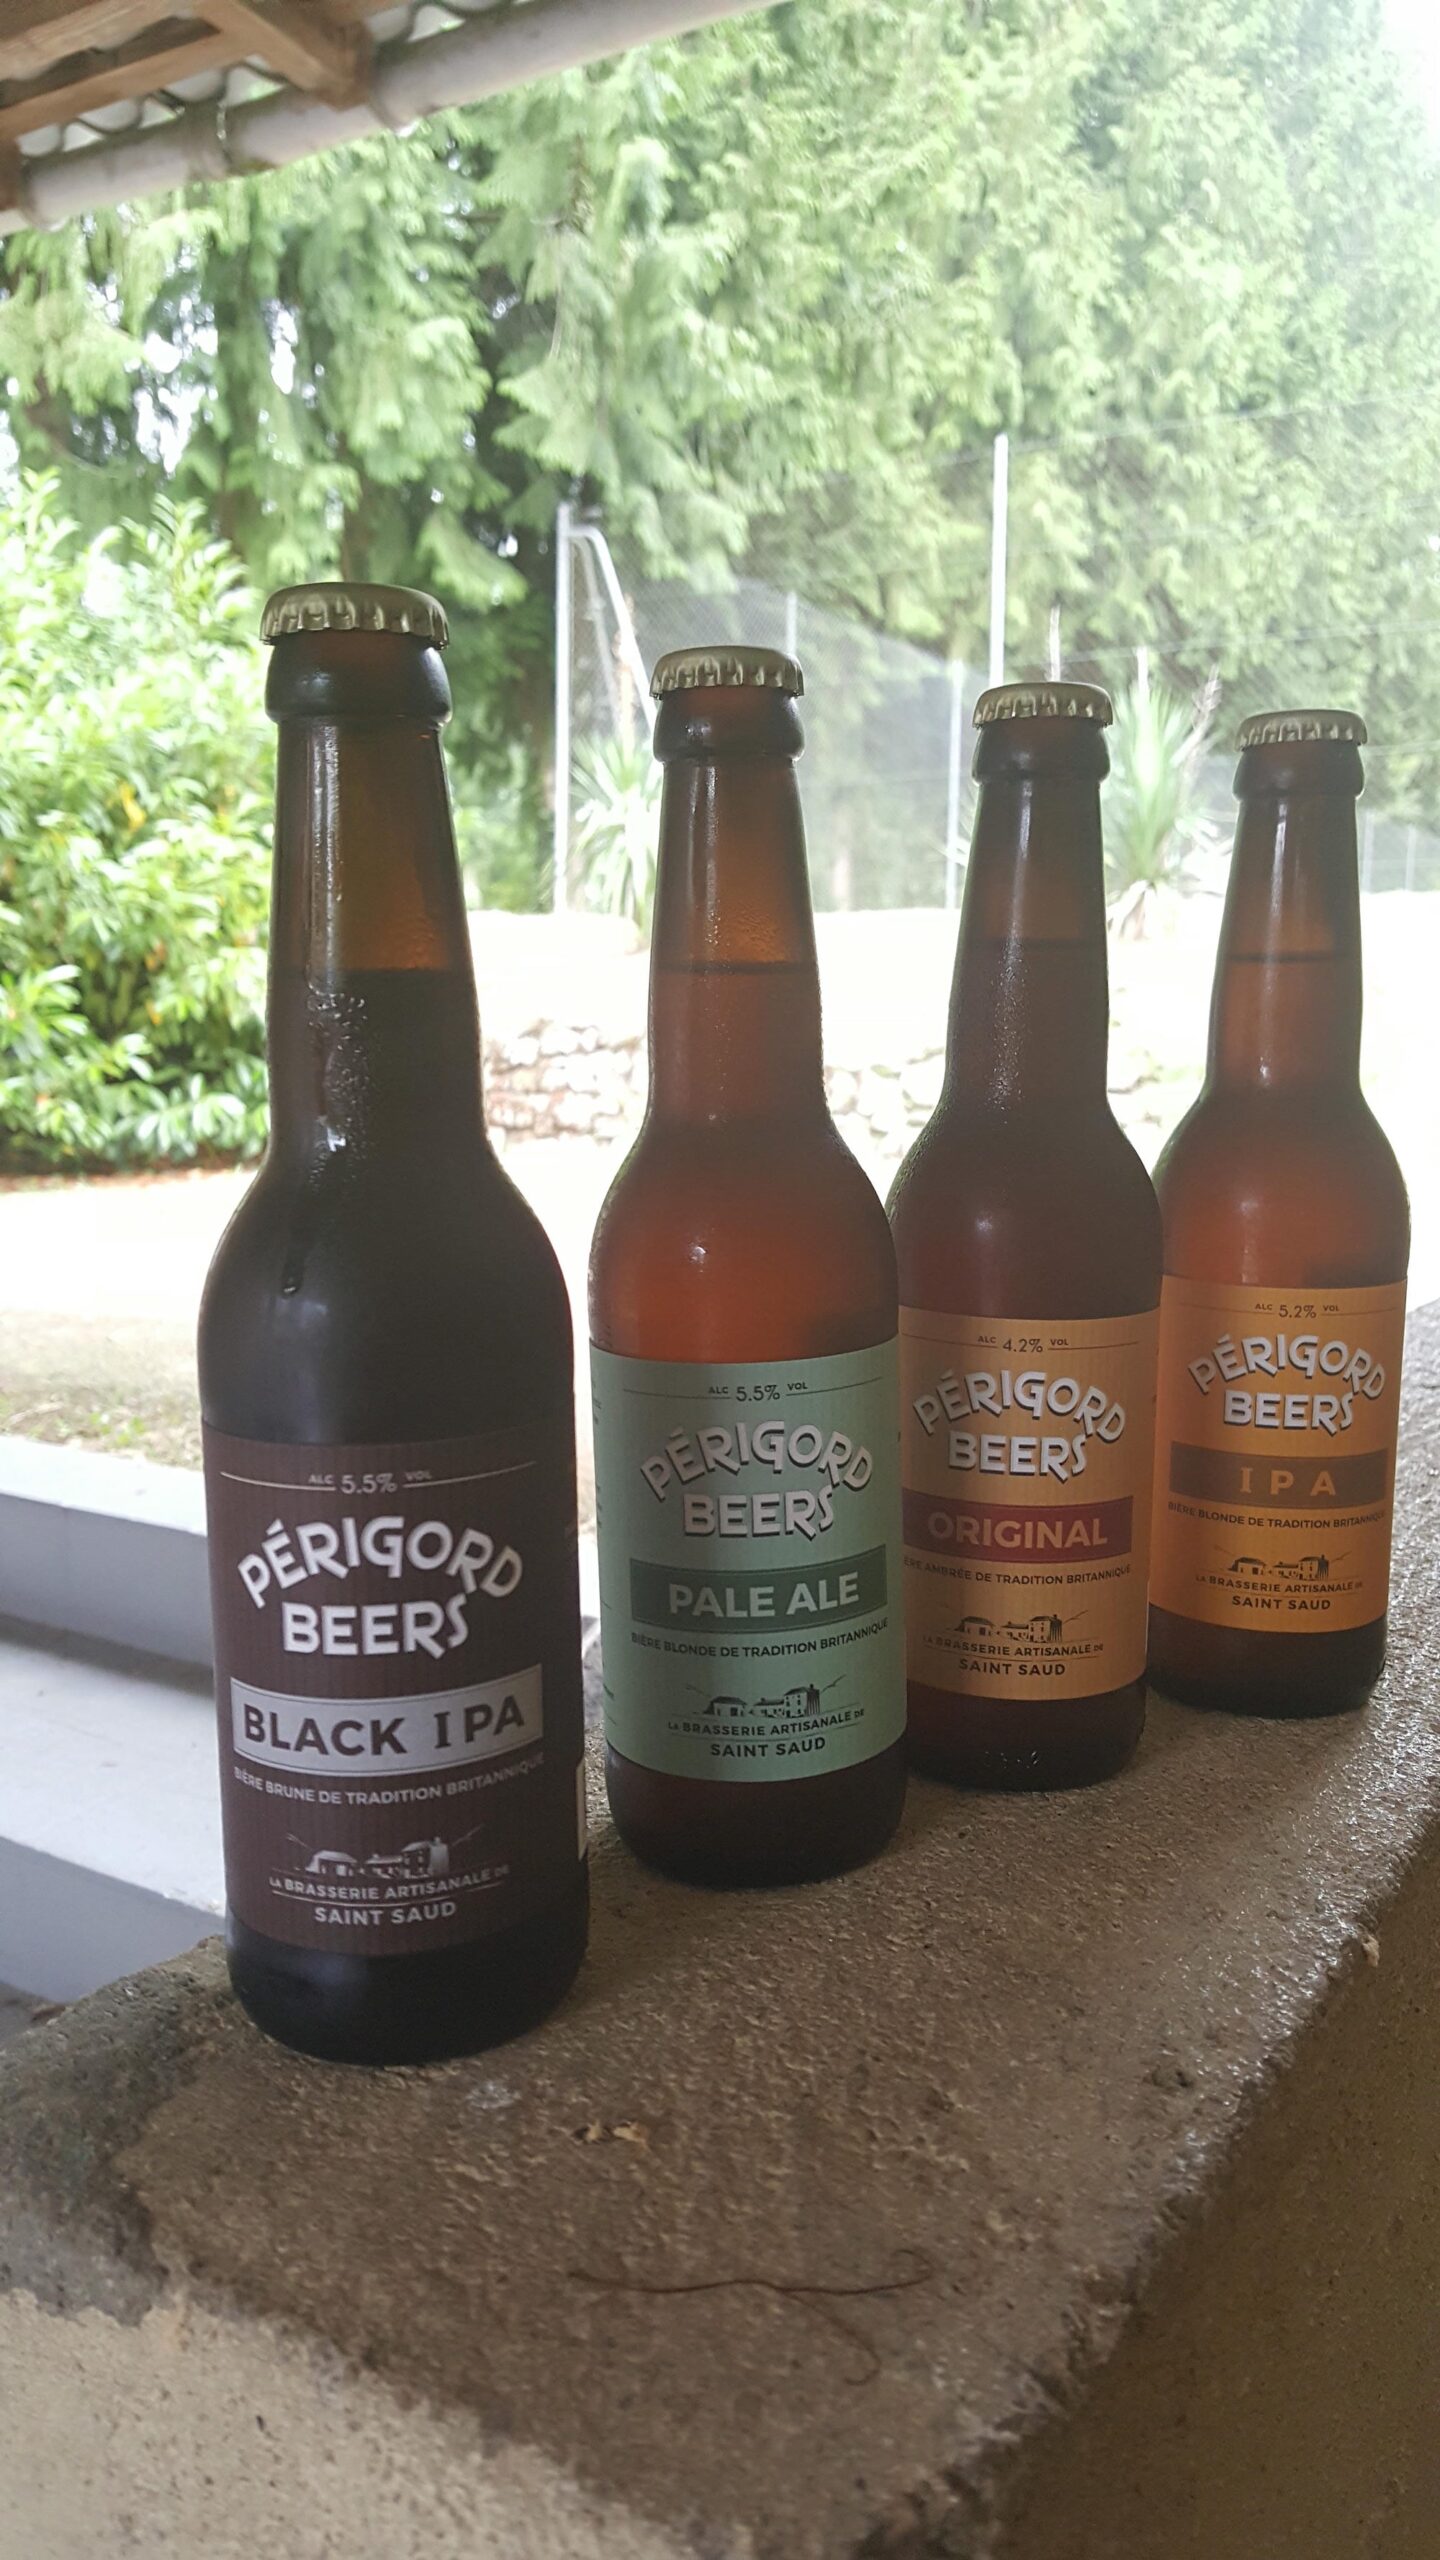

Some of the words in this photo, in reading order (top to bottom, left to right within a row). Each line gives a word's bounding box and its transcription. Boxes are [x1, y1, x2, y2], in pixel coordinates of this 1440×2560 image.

[1254, 1303, 1273, 1312] ALC
[1278, 1304, 1318, 1319] 5.2%
[1322, 1304, 1340, 1313] VOL
[977, 1335, 997, 1345] ALC
[1002, 1338, 1044, 1354] 4.2%
[1050, 1338, 1070, 1347] VOL
[1187, 1333, 1387, 1400] PÉRIGORD
[708, 1385, 729, 1395] ALC
[735, 1384, 781, 1402] 5.5%
[787, 1381, 808, 1392] VOL
[912, 1369, 1127, 1444] PÉRIGORD
[1223, 1389, 1355, 1437] BEERS
[640, 1420, 874, 1503] PÉRIGORD
[949, 1429, 1088, 1484] BEERS
[308, 1473, 334, 1485] ALC
[340, 1473, 397, 1494] 5.5%
[405, 1470, 432, 1481] VOL
[682, 1484, 835, 1541] BEERS
[1197, 1508, 1245, 1525] BLONDE
[1248, 1517, 1265, 1527] DE
[1267, 1517, 1331, 1530] TRADITION
[1333, 1510, 1387, 1528] BRITANNIQUE
[927, 1510, 1109, 1550] ORIGINAL
[237, 1516, 523, 1609] PÉRIGORD
[923, 1562, 973, 1580] AMBRÉE
[975, 1572, 993, 1583] DE
[996, 1572, 1063, 1586] TRADITION
[1066, 1563, 1132, 1585] BRITANNIQUE
[667, 1582, 777, 1619] PALE
[785, 1571, 860, 1616] ALE
[1208, 1575, 1281, 1593] BRASSERIE
[1284, 1581, 1354, 1594] ARTISANALE
[1231, 1595, 1283, 1610] SAINT
[1287, 1599, 1331, 1611] SAUD
[282, 1594, 469, 1660] BEERS
[663, 1640, 717, 1657] BLONDE
[720, 1646, 740, 1658] DE
[742, 1640, 817, 1659] TRADITION
[820, 1617, 889, 1649] BRITANNIQUE
[935, 1636, 1011, 1656] BRASSERIE
[1014, 1643, 1091, 1657] ARTISANALE
[1093, 1643, 1104, 1652] DE
[958, 1659, 1012, 1676] SAINT
[1017, 1663, 1066, 1676] SAUD
[243, 1703, 408, 1756] BLACK
[668, 1720, 680, 1731] LA
[682, 1721, 766, 1737] BRASSERIE
[770, 1710, 852, 1736] ARTISANALE
[853, 1708, 866, 1719] DE
[710, 1742, 769, 1758] SAINT
[775, 1736, 826, 1757] SAUD
[233, 1766, 264, 1792] BIÈRE
[265, 1781, 316, 1802] BRUNE
[319, 1791, 342, 1804] DE
[346, 1784, 442, 1806] TRADITION
[446, 1752, 545, 1795] BRITANNIQUE
[268, 1876, 283, 1888] LA
[284, 1877, 380, 1901] BRASSERIE
[384, 1870, 490, 1900] ARTISANALE
[313, 1907, 384, 1926] SAINT
[391, 1902, 457, 1924] SAUD
